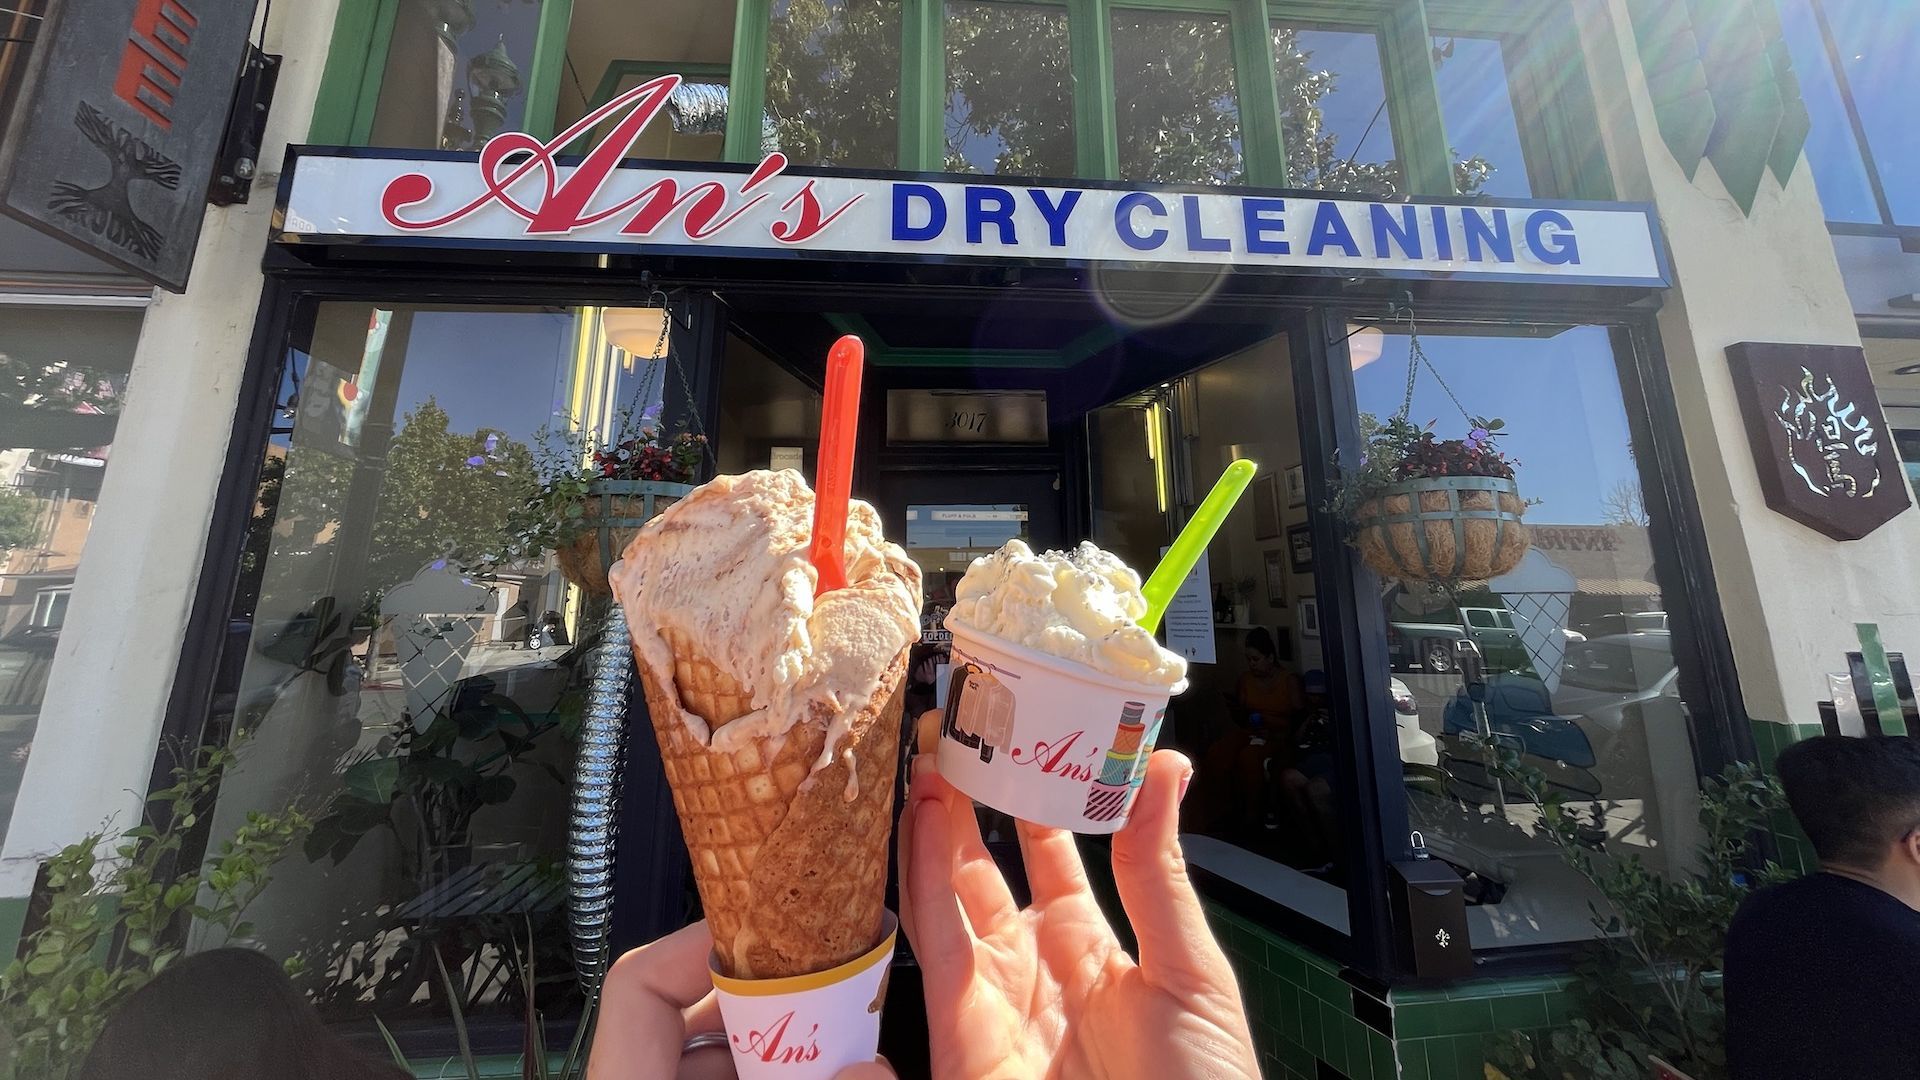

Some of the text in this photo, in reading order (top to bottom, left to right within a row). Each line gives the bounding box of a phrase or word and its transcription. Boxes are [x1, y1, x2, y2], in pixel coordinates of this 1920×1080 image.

[381, 74, 1581, 265] An's DRY CLEANING
[945, 411, 987, 432] 3017
[1011, 730, 1098, 782] An's
[732, 1010, 821, 1064] An's
